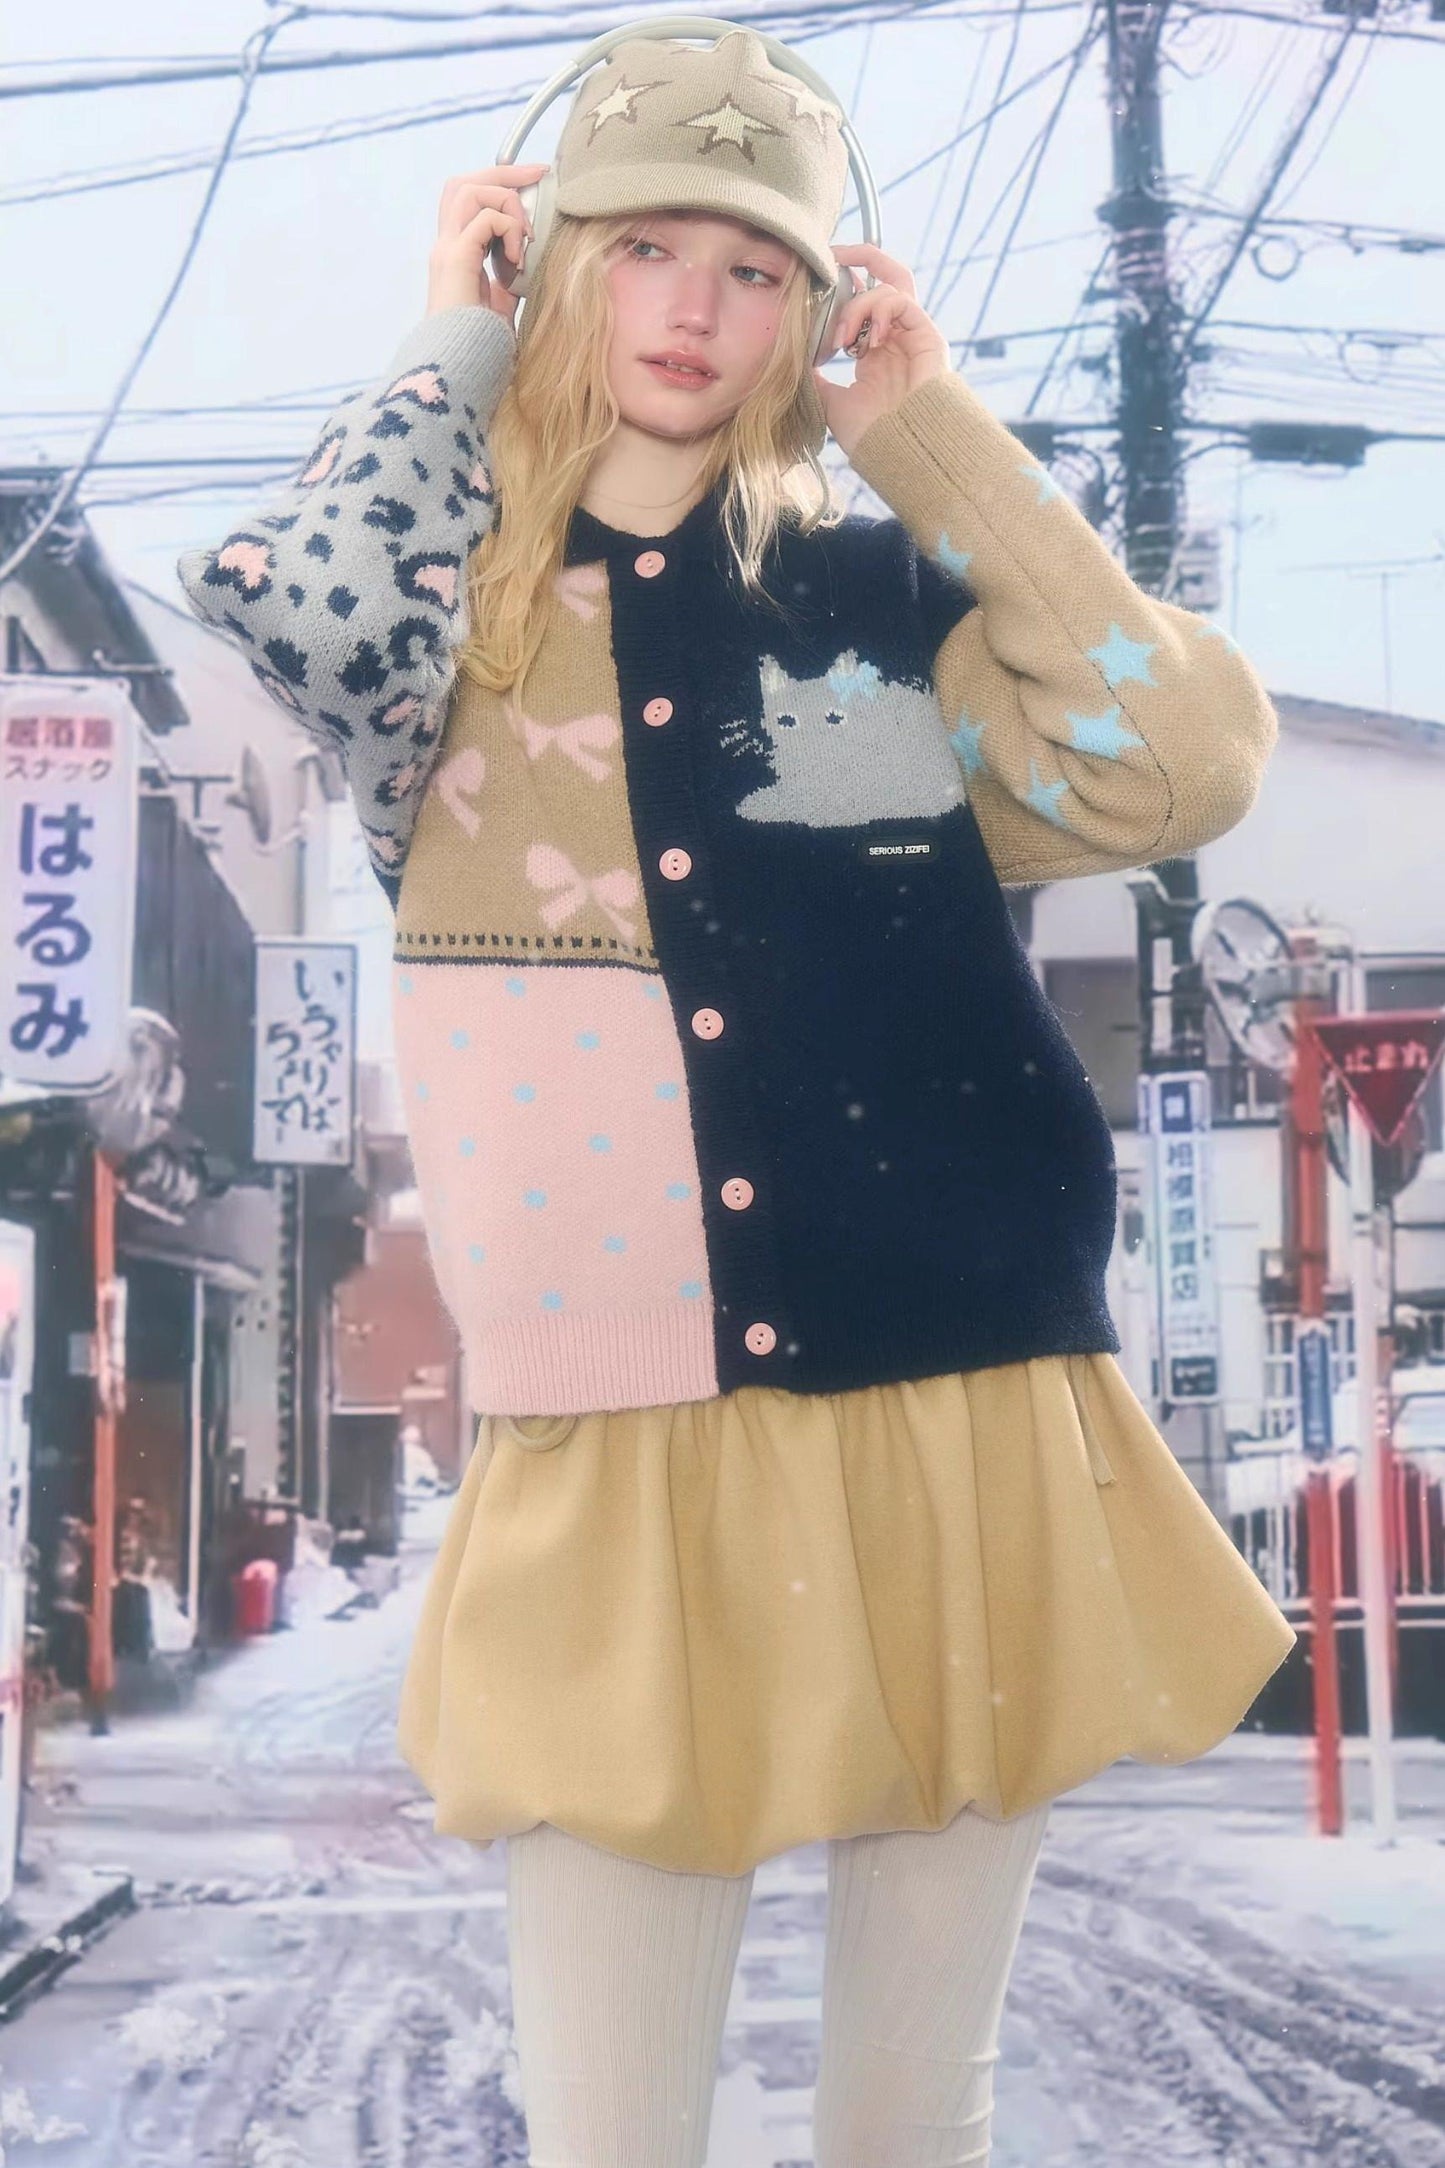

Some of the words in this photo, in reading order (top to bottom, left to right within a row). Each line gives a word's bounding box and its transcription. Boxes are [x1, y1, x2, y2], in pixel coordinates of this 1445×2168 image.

[5, 755, 112, 782] スナック
[869, 846, 903, 855] SERIOUS
[10, 803, 94, 1058] はるみ
